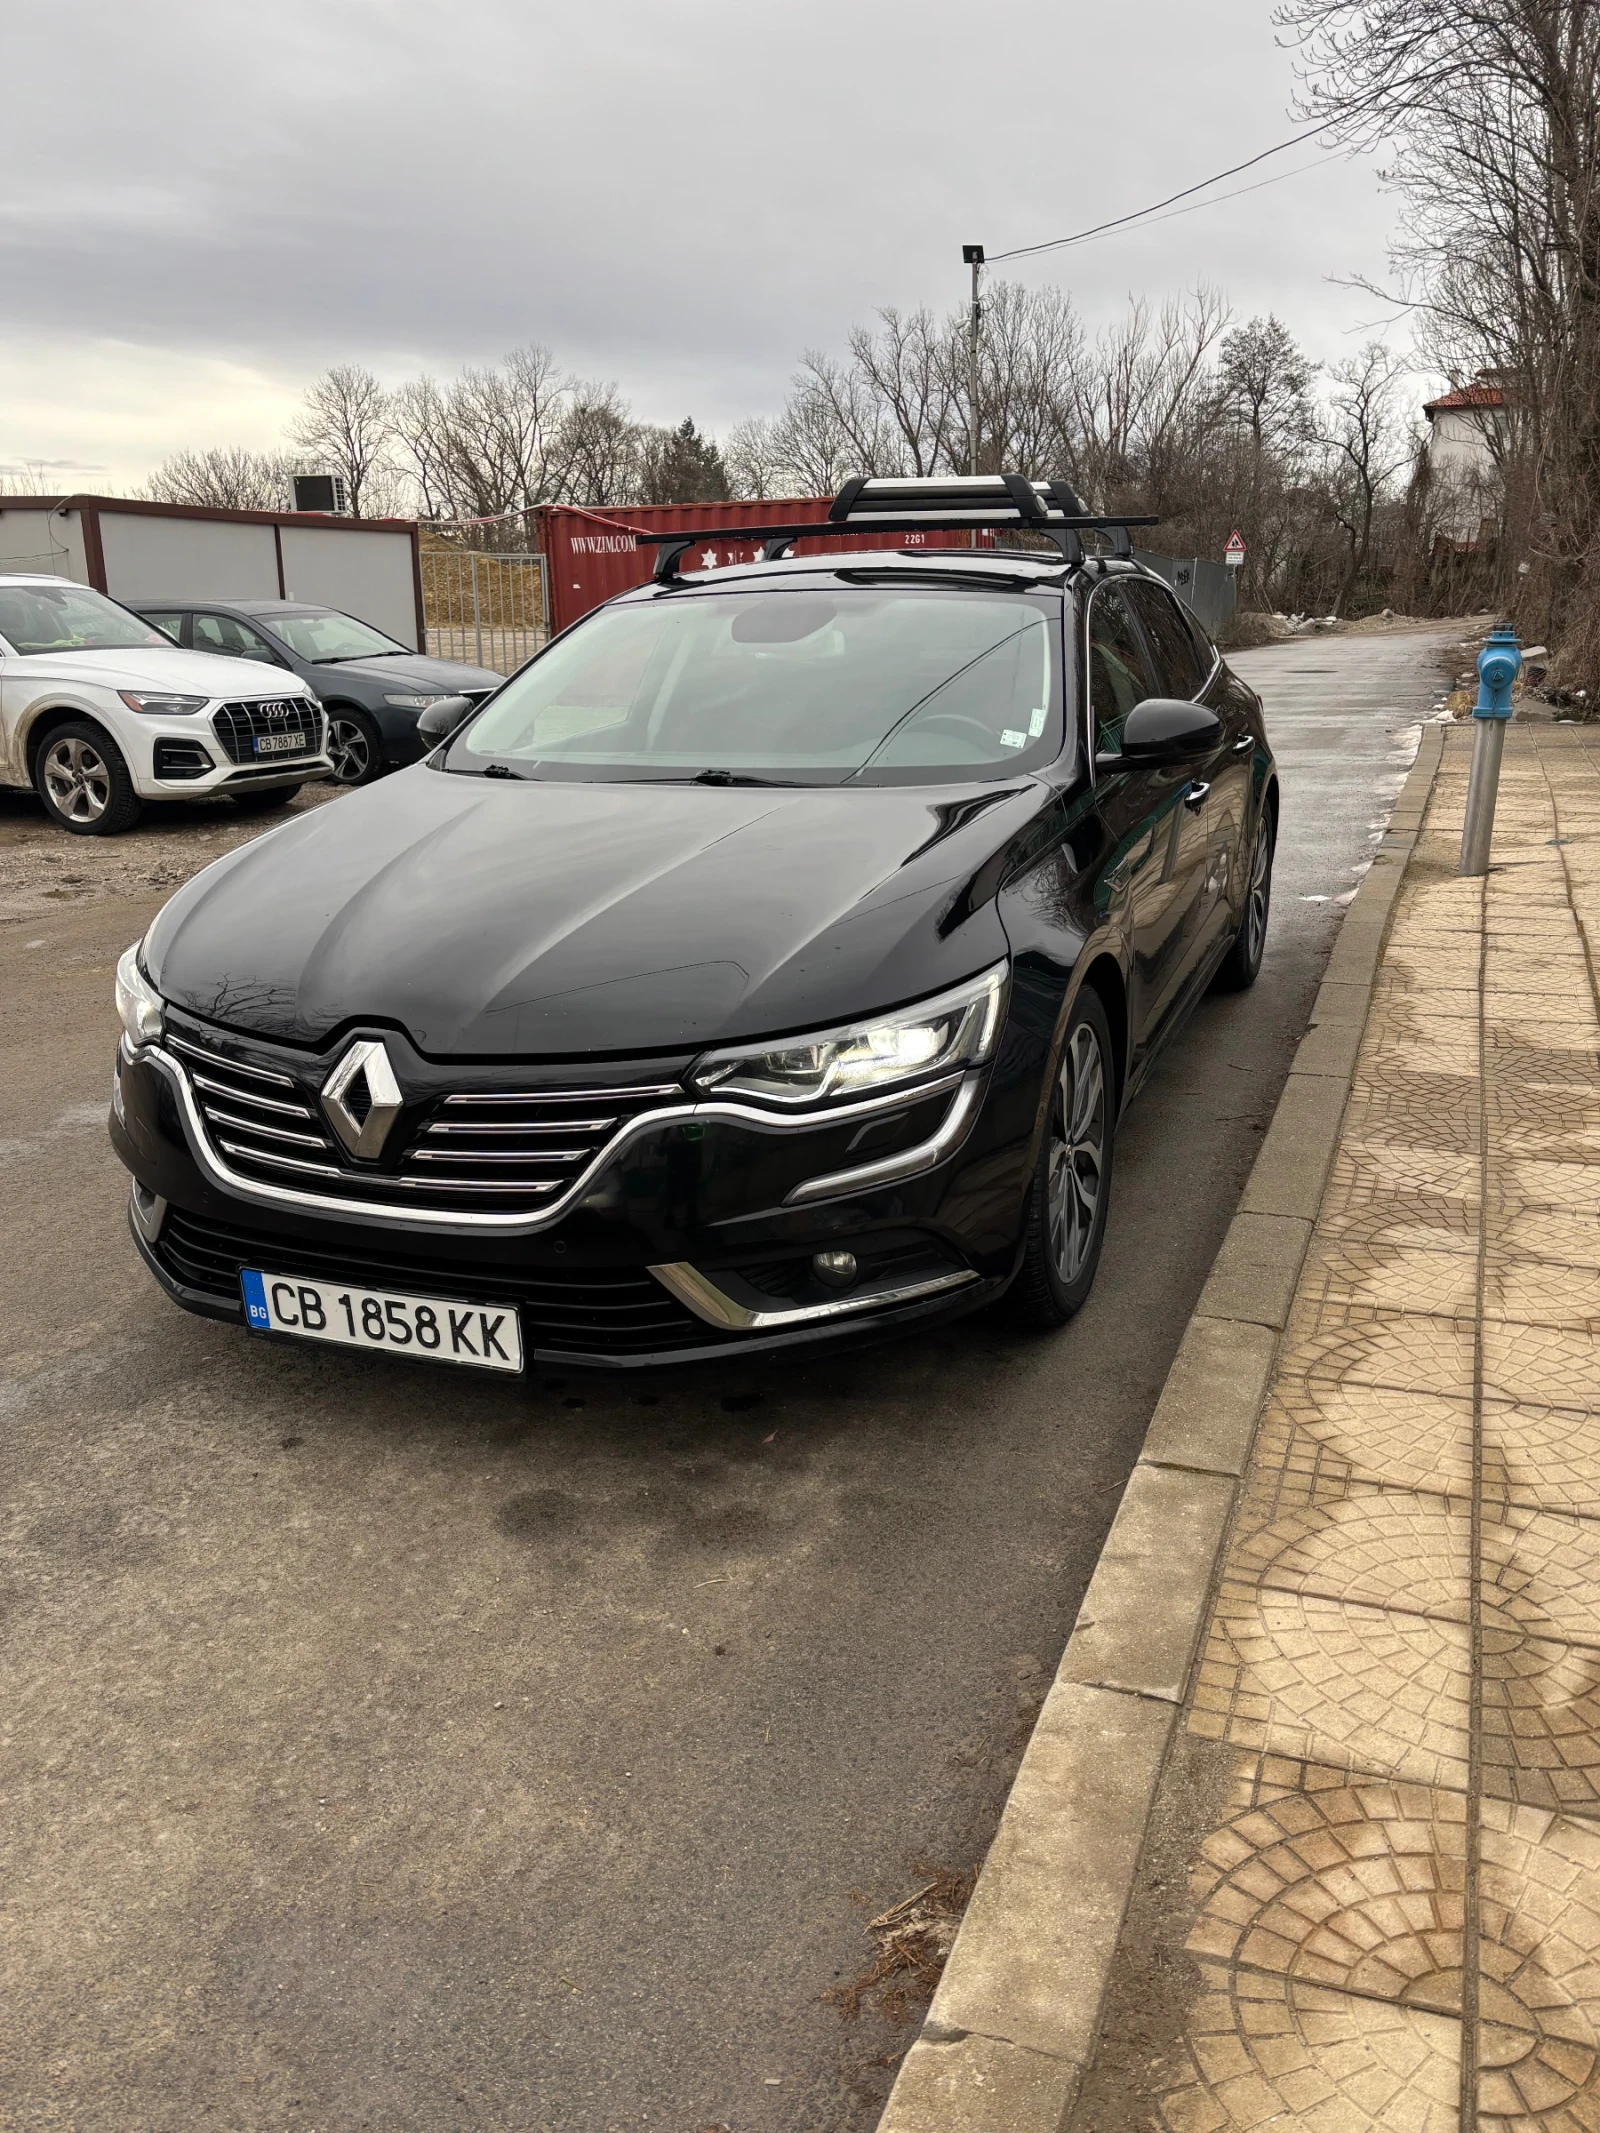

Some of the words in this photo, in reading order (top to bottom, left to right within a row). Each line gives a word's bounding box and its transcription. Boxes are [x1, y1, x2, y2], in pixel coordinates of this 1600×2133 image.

[259, 738, 271, 751] CB
[272, 735, 293, 750] 7887
[293, 734, 305, 747] XE
[249, 1305, 267, 1319] BG
[271, 1282, 327, 1330] CB
[338, 1293, 441, 1349] 1858
[448, 1309, 511, 1361] KK
